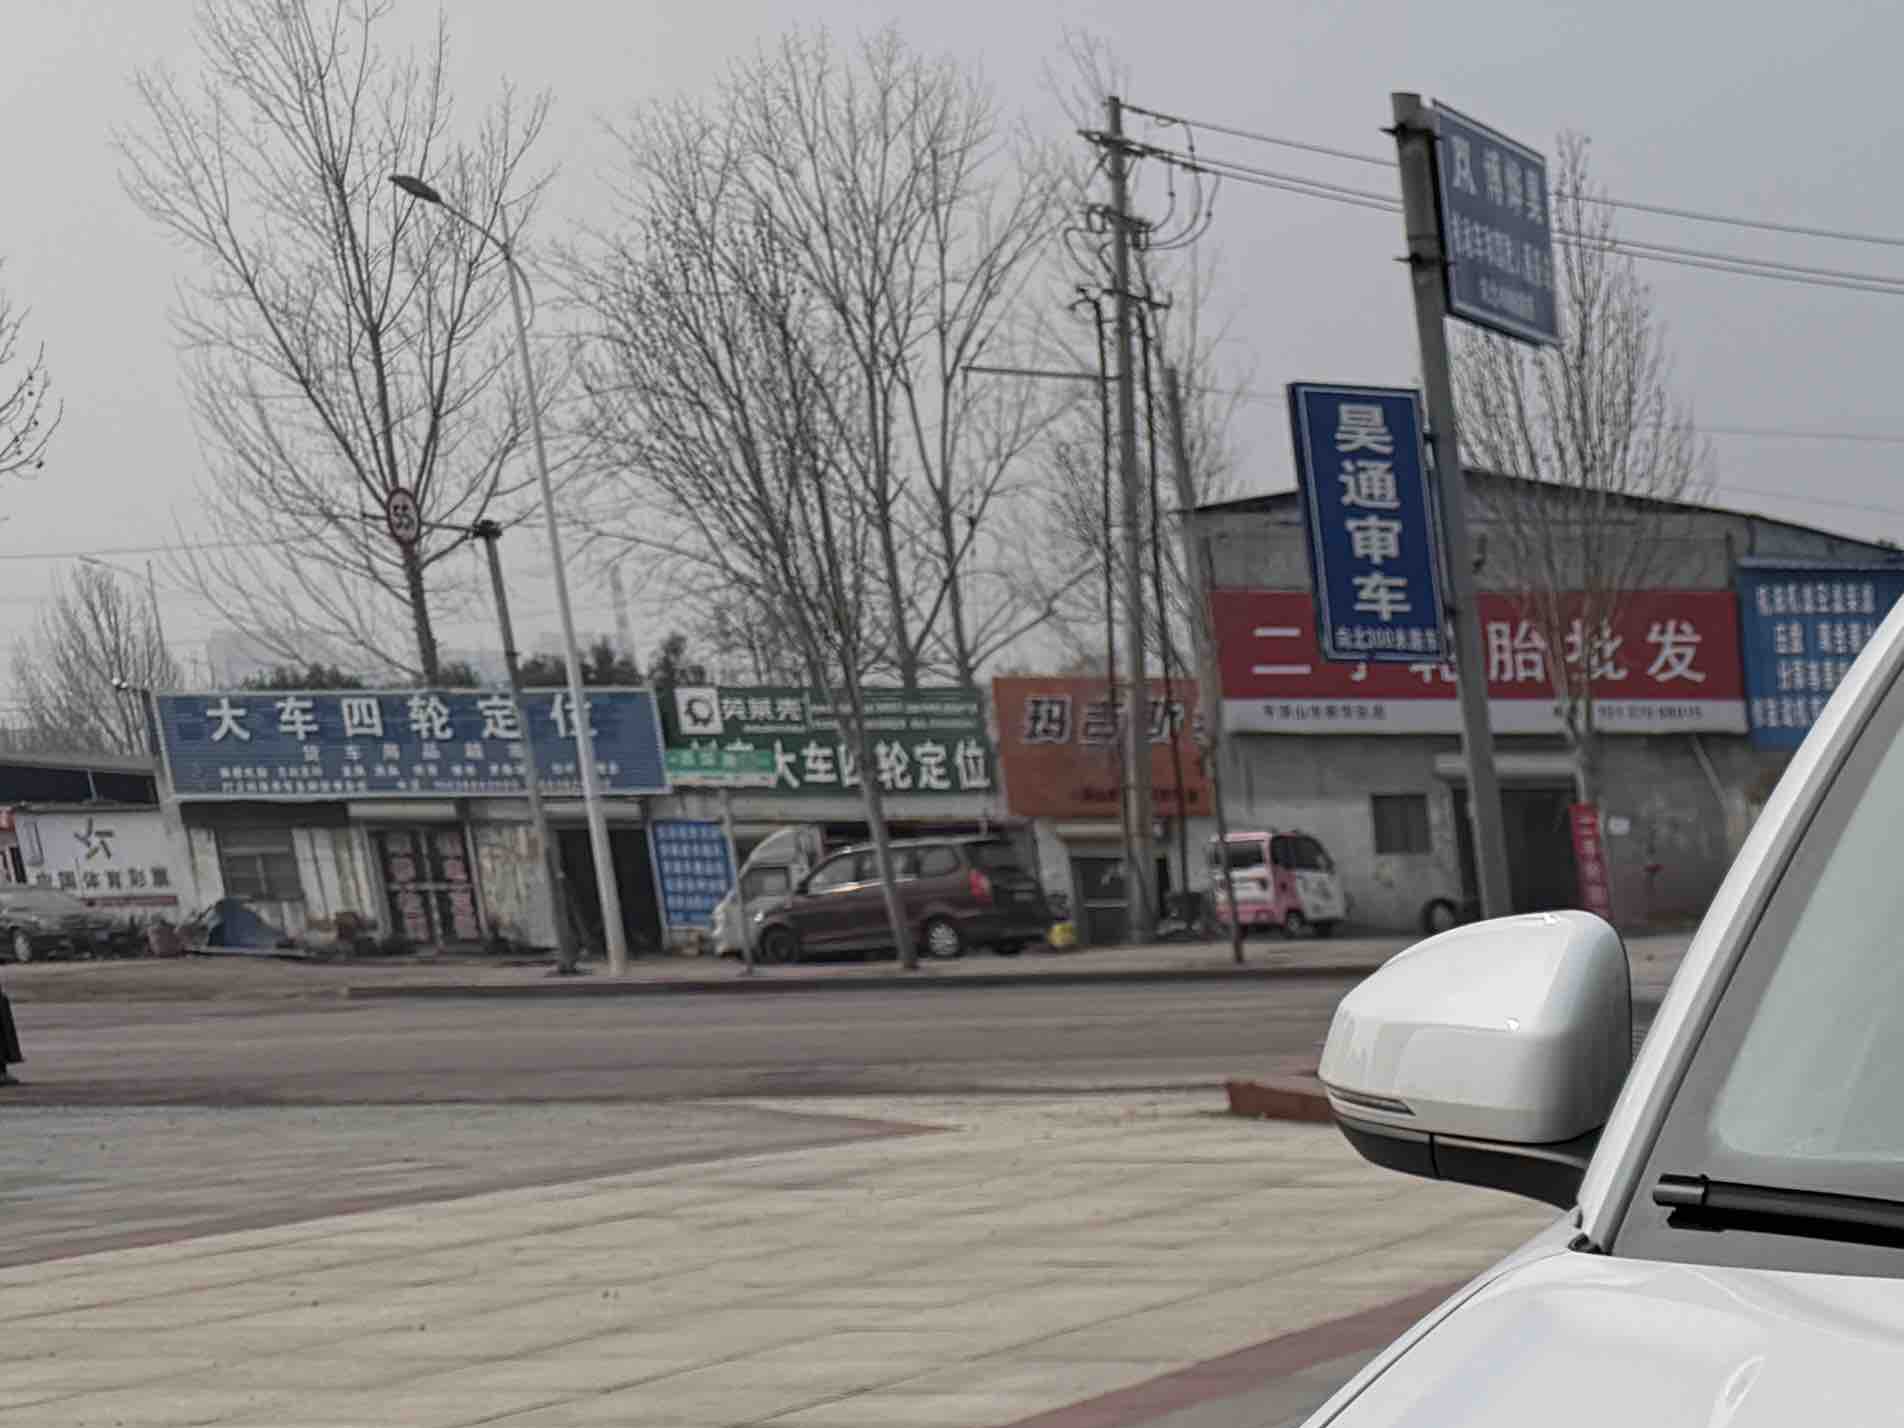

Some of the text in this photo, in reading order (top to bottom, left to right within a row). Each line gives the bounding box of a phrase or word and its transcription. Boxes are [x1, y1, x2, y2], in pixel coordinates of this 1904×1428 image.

[1334, 403, 1412, 622] 昊通审车
[206, 695, 598, 742] 大车四轮定位
